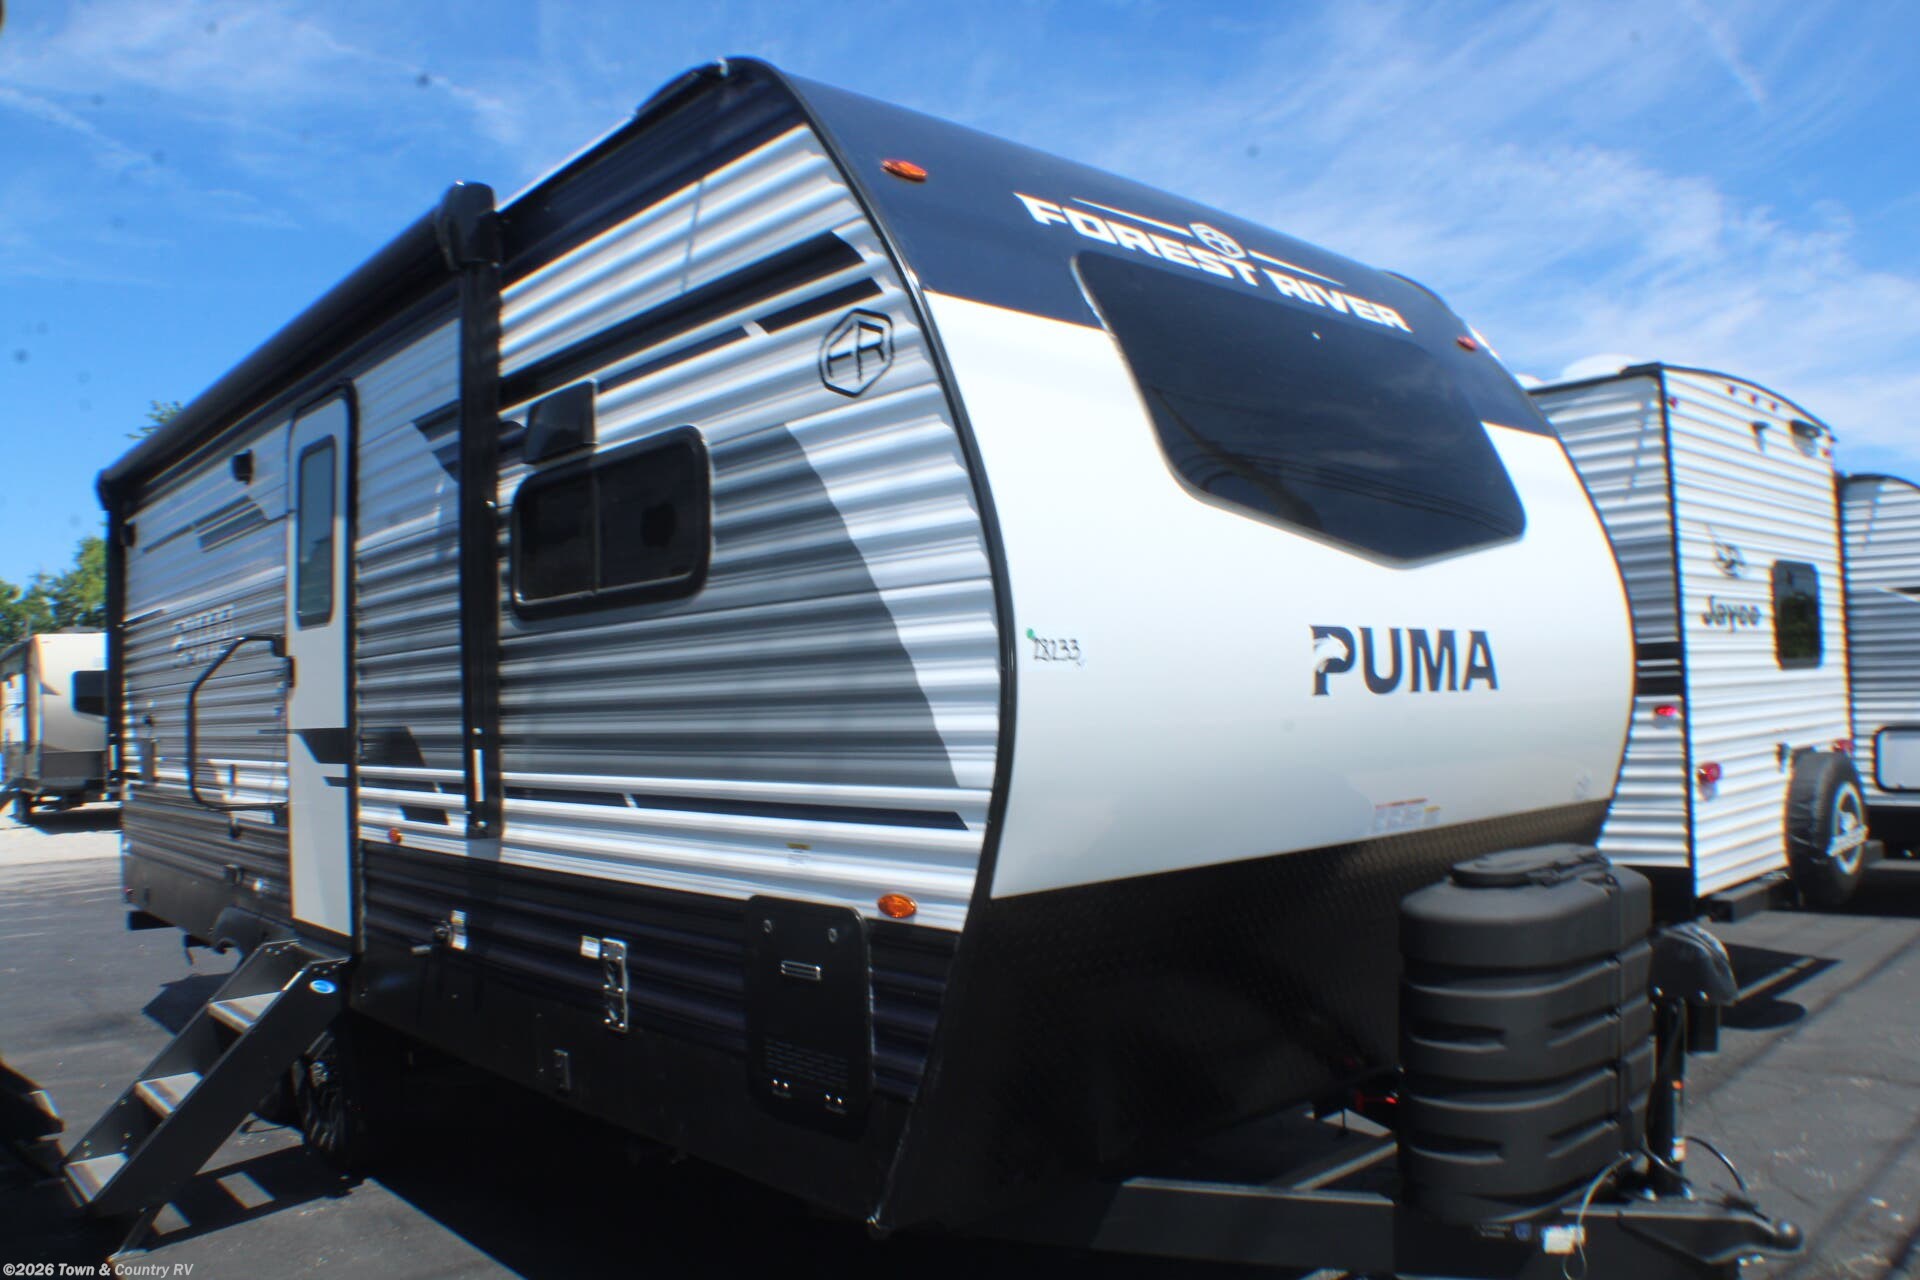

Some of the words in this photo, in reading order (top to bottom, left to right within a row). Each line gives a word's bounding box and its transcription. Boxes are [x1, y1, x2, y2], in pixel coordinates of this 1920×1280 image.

[1013, 192, 1258, 286] FOREST
[1261, 268, 1413, 333] RIVER
[1310, 624, 1499, 696] PUMA
